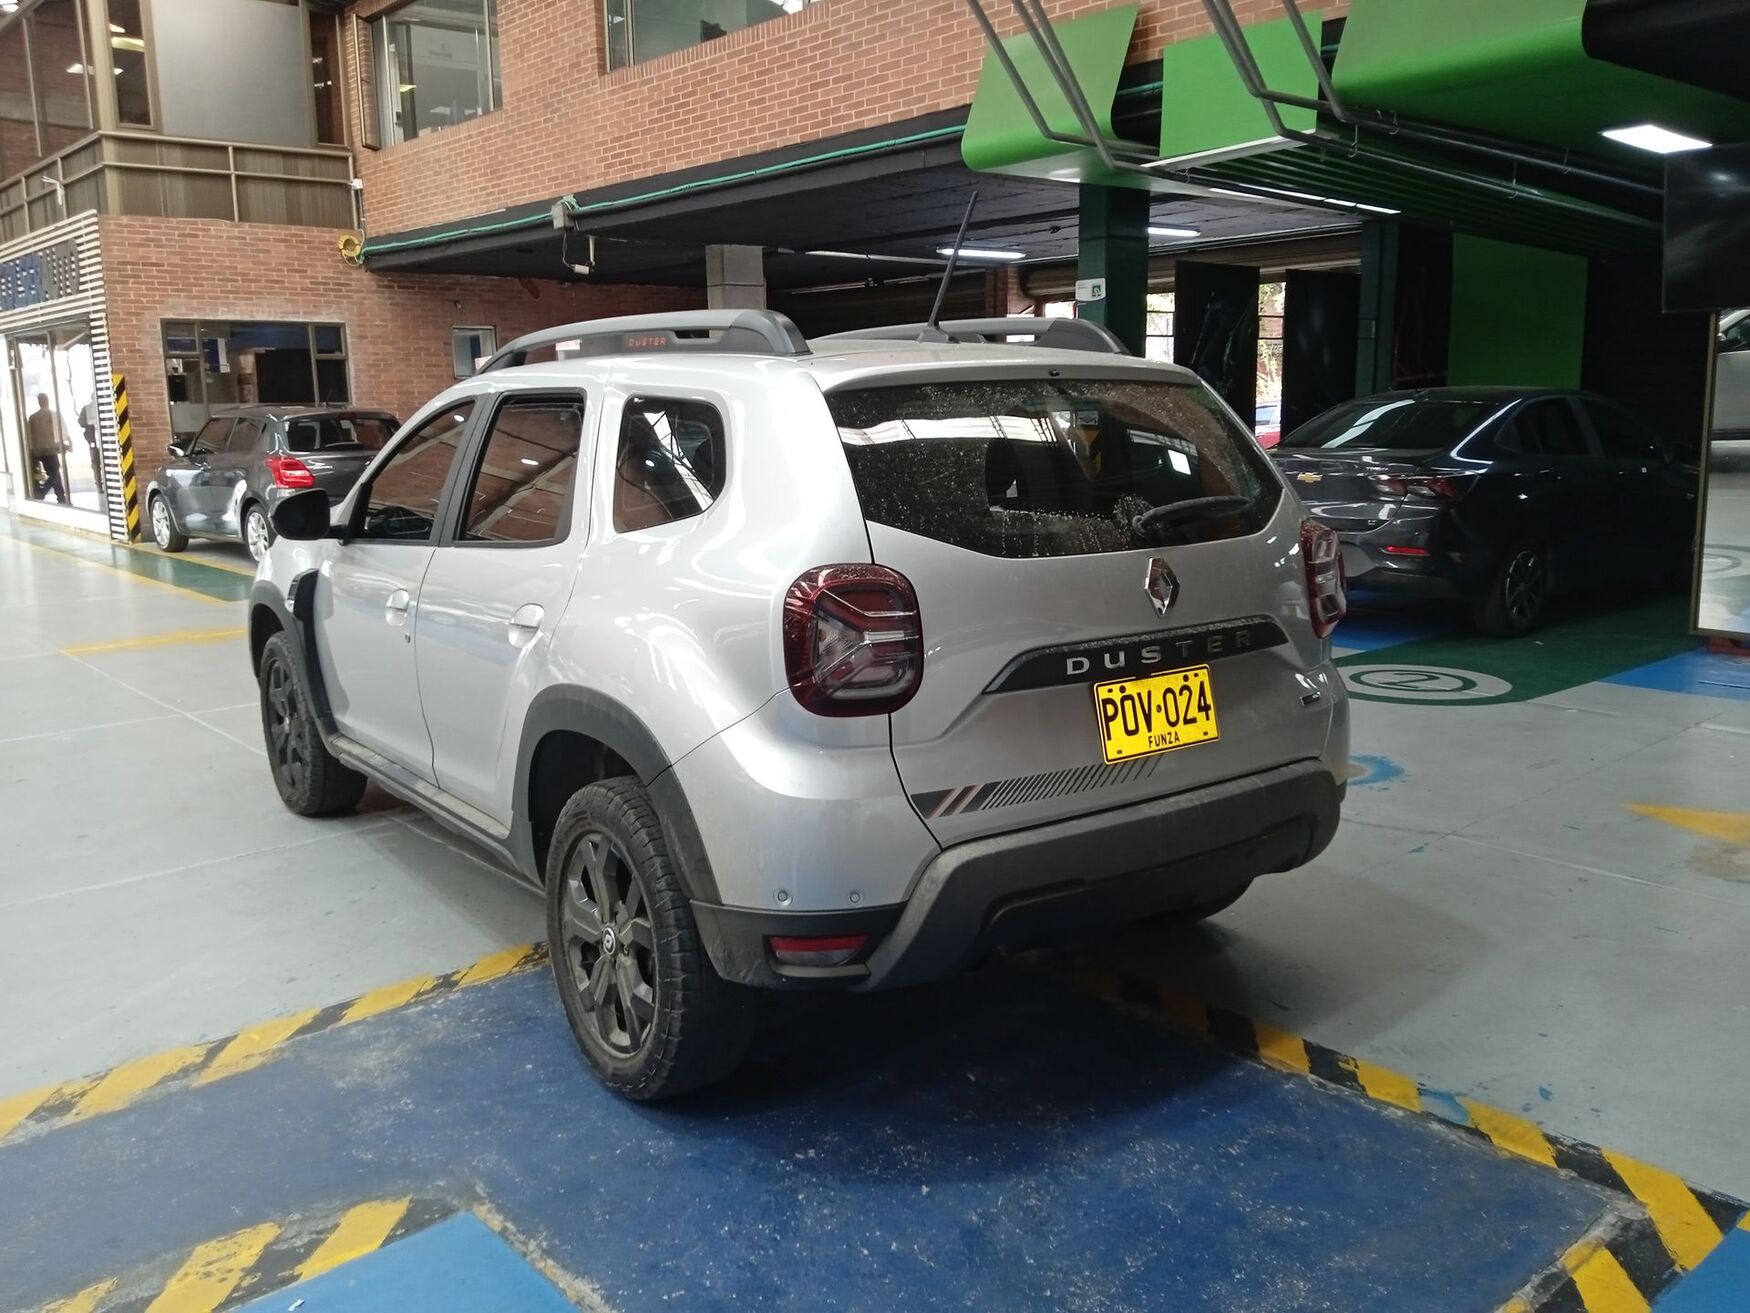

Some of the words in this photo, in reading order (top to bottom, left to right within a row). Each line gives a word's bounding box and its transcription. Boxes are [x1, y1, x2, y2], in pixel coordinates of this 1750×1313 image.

[628, 336, 668, 347] DUSTER
[1066, 630, 1251, 675] DUSTER
[1148, 731, 1180, 748] FUNZA
